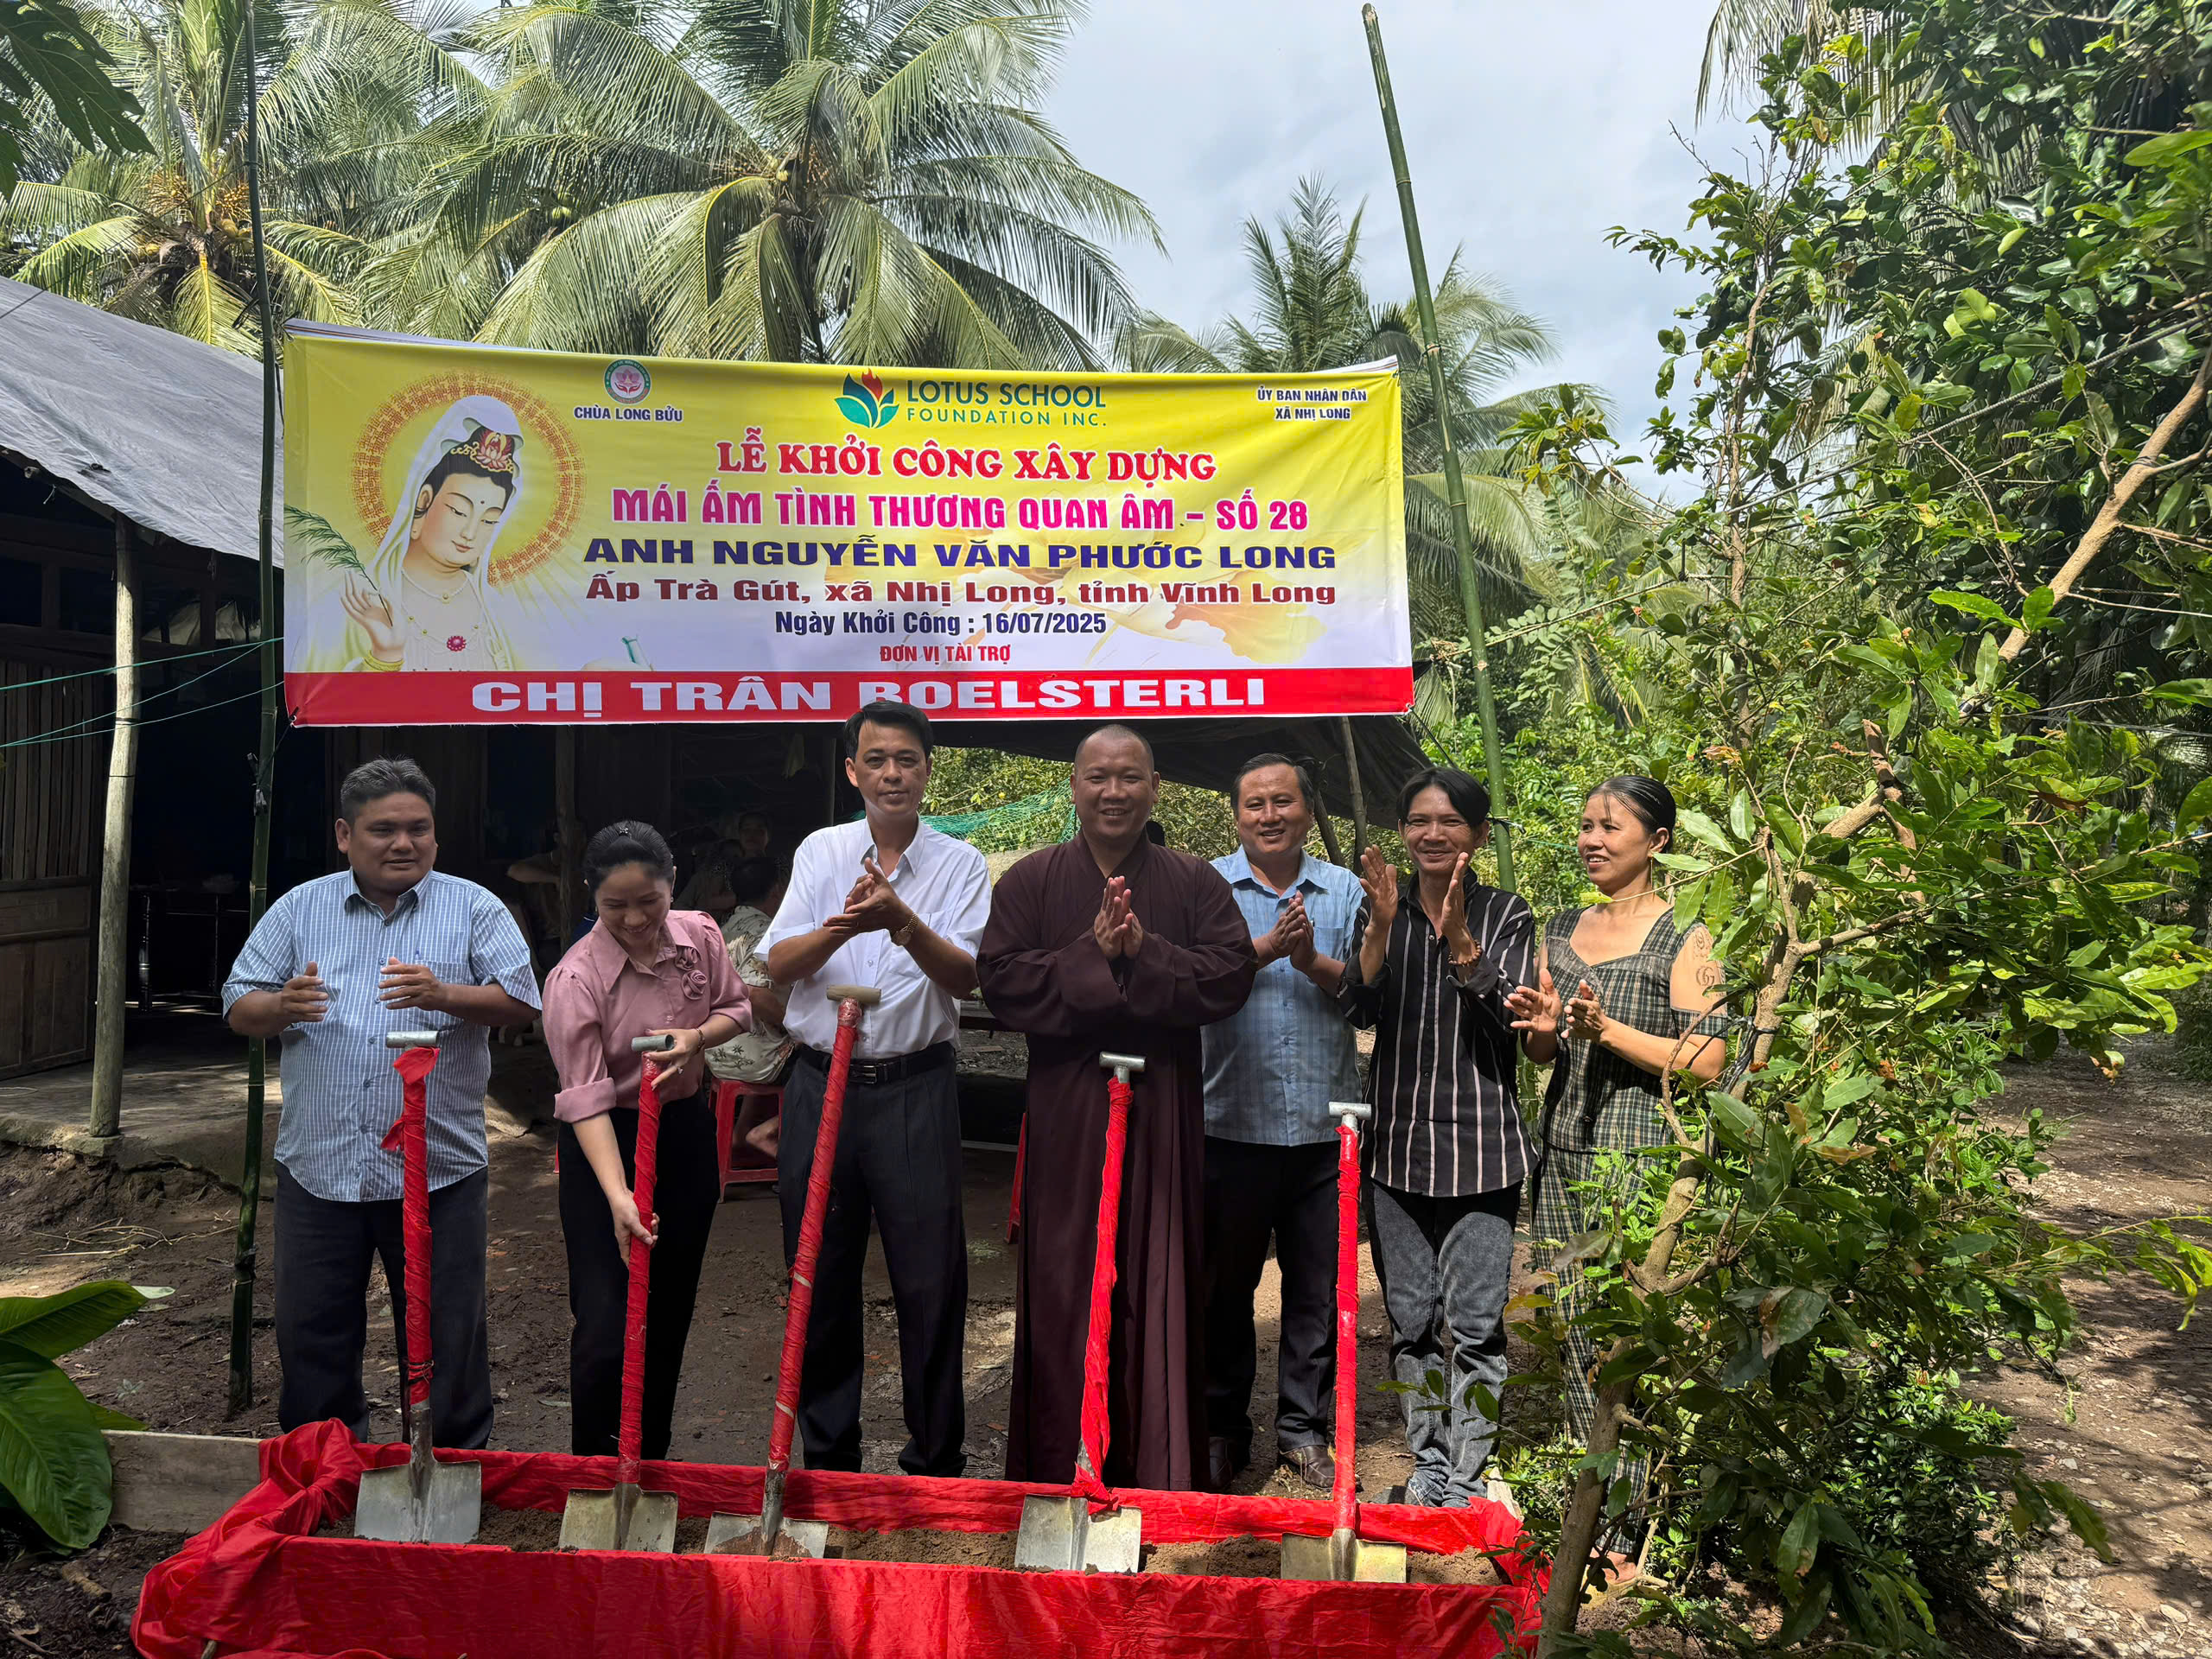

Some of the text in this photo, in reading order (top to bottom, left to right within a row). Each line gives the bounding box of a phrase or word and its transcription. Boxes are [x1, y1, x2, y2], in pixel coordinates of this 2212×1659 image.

[908, 380, 1106, 408] LOTUS SCHOOL
[1257, 385, 1367, 402] ỦY BAN NHÂN DÂN
[574, 404, 683, 422] CHÙA LONG BỬU
[908, 407, 1108, 427] FOUNDATION INC.
[1274, 406, 1351, 422] XÃ NHỊ LONG
[717, 427, 1217, 489] LỄ KHỞI CÔNG XÂY DỰNG
[613, 483, 687, 523] MÁI
[702, 478, 762, 524] ẤM
[774, 486, 856, 525] TÌNH
[869, 493, 1004, 528] THƯƠNG
[1019, 498, 1109, 530] QUAN
[1122, 493, 1173, 530] ÂM
[1217, 488, 1259, 530] SỐ
[1270, 499, 1308, 530] 28
[583, 533, 1336, 569] ANH NGUYỄN VĂN PHƯỚC LONG
[587, 570, 1336, 607] Ấp Trà Gút, xã Nhị Long, tỉnh Vĩnh Long
[775, 611, 836, 635] Ngày
[842, 609, 896, 633] Khởi
[904, 611, 961, 635] Công
[983, 613, 1107, 634] 16/07/2025
[880, 644, 1011, 664] ĐƠN VỊ TÀI TRỢ
[472, 676, 1265, 717] CHỊ TRÂN BOELSTERLI
